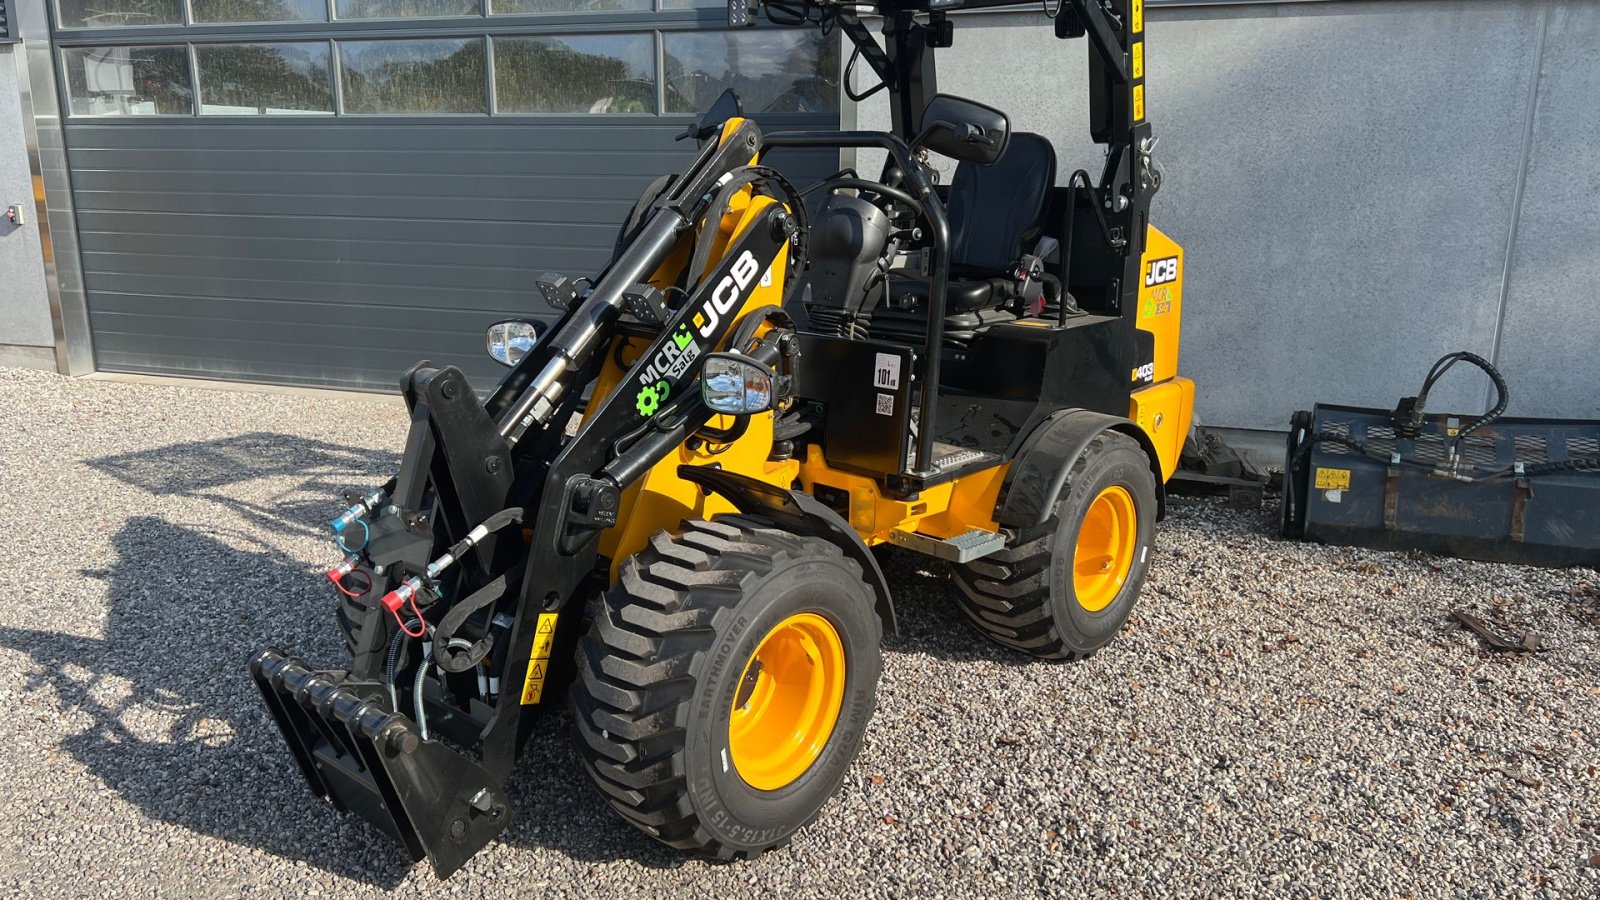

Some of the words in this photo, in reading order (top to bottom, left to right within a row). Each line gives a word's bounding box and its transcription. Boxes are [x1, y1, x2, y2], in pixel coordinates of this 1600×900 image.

[1145, 258, 1178, 286] JCB
[699, 249, 759, 339] JCB
[672, 349, 696, 378] Salg
[877, 368, 891, 386] 101
[698, 615, 748, 719] EARTHMOVER
